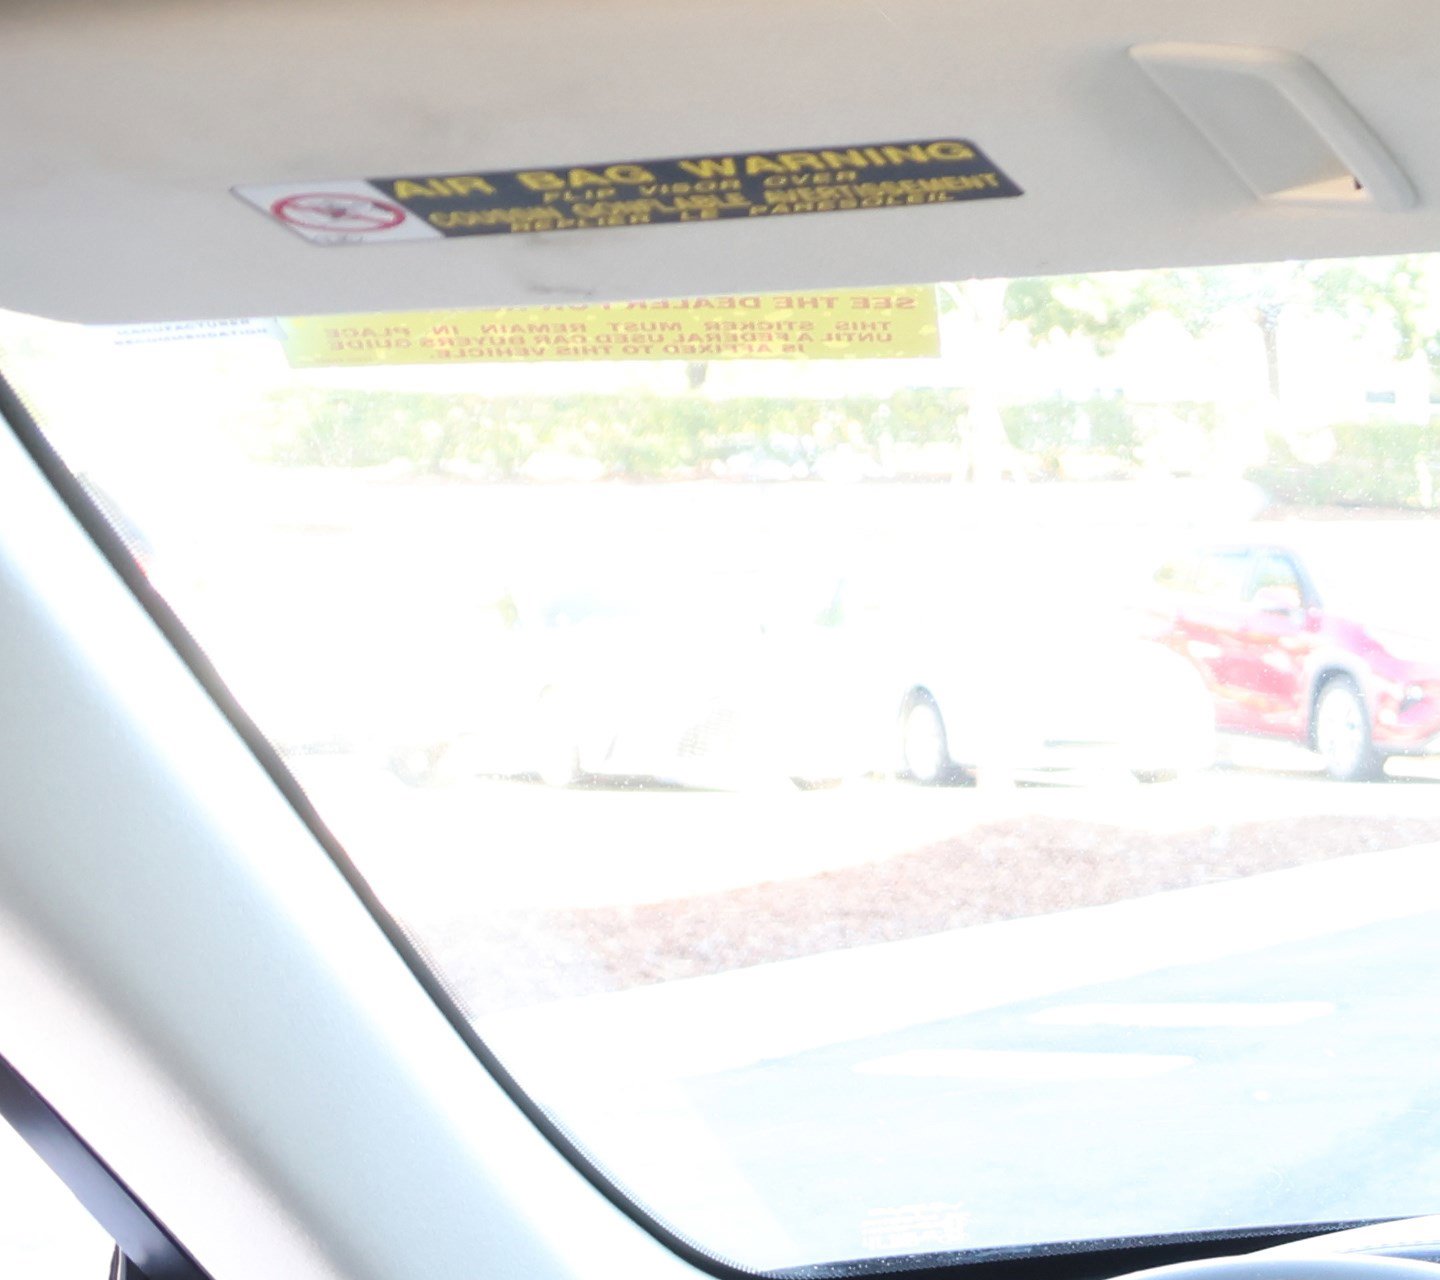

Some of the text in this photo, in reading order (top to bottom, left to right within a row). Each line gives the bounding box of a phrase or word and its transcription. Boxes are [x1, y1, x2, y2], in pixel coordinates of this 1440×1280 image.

[393, 141, 978, 199] AIR BAG WARNING
